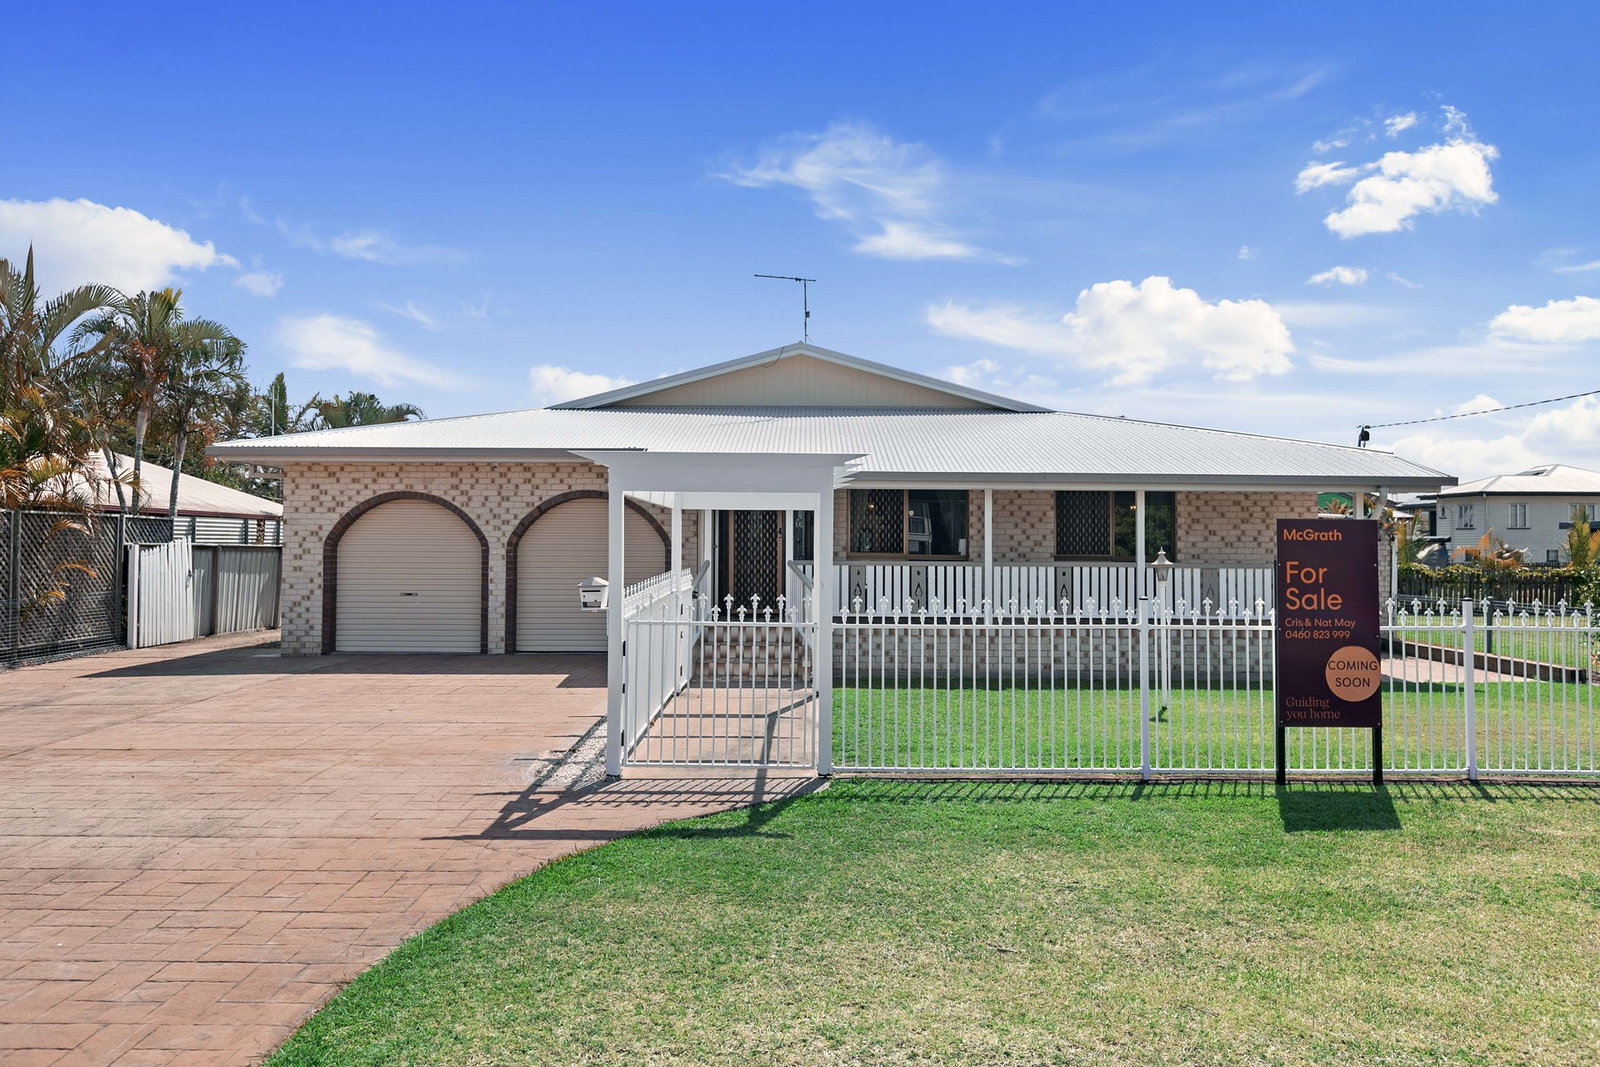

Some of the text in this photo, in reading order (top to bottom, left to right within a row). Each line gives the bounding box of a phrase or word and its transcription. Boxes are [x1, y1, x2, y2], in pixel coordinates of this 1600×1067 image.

[1283, 528, 1342, 541] McGrath
[1286, 561, 1328, 584] For
[1285, 587, 1343, 610] Sale
[1285, 617, 1356, 630] Cris & Nat May
[1285, 630, 1351, 640] 0460 823 999
[1328, 660, 1378, 671] COMING
[1335, 677, 1371, 688] SOON
[1286, 696, 1330, 709] Guiding
[1286, 708, 1341, 721] you home
